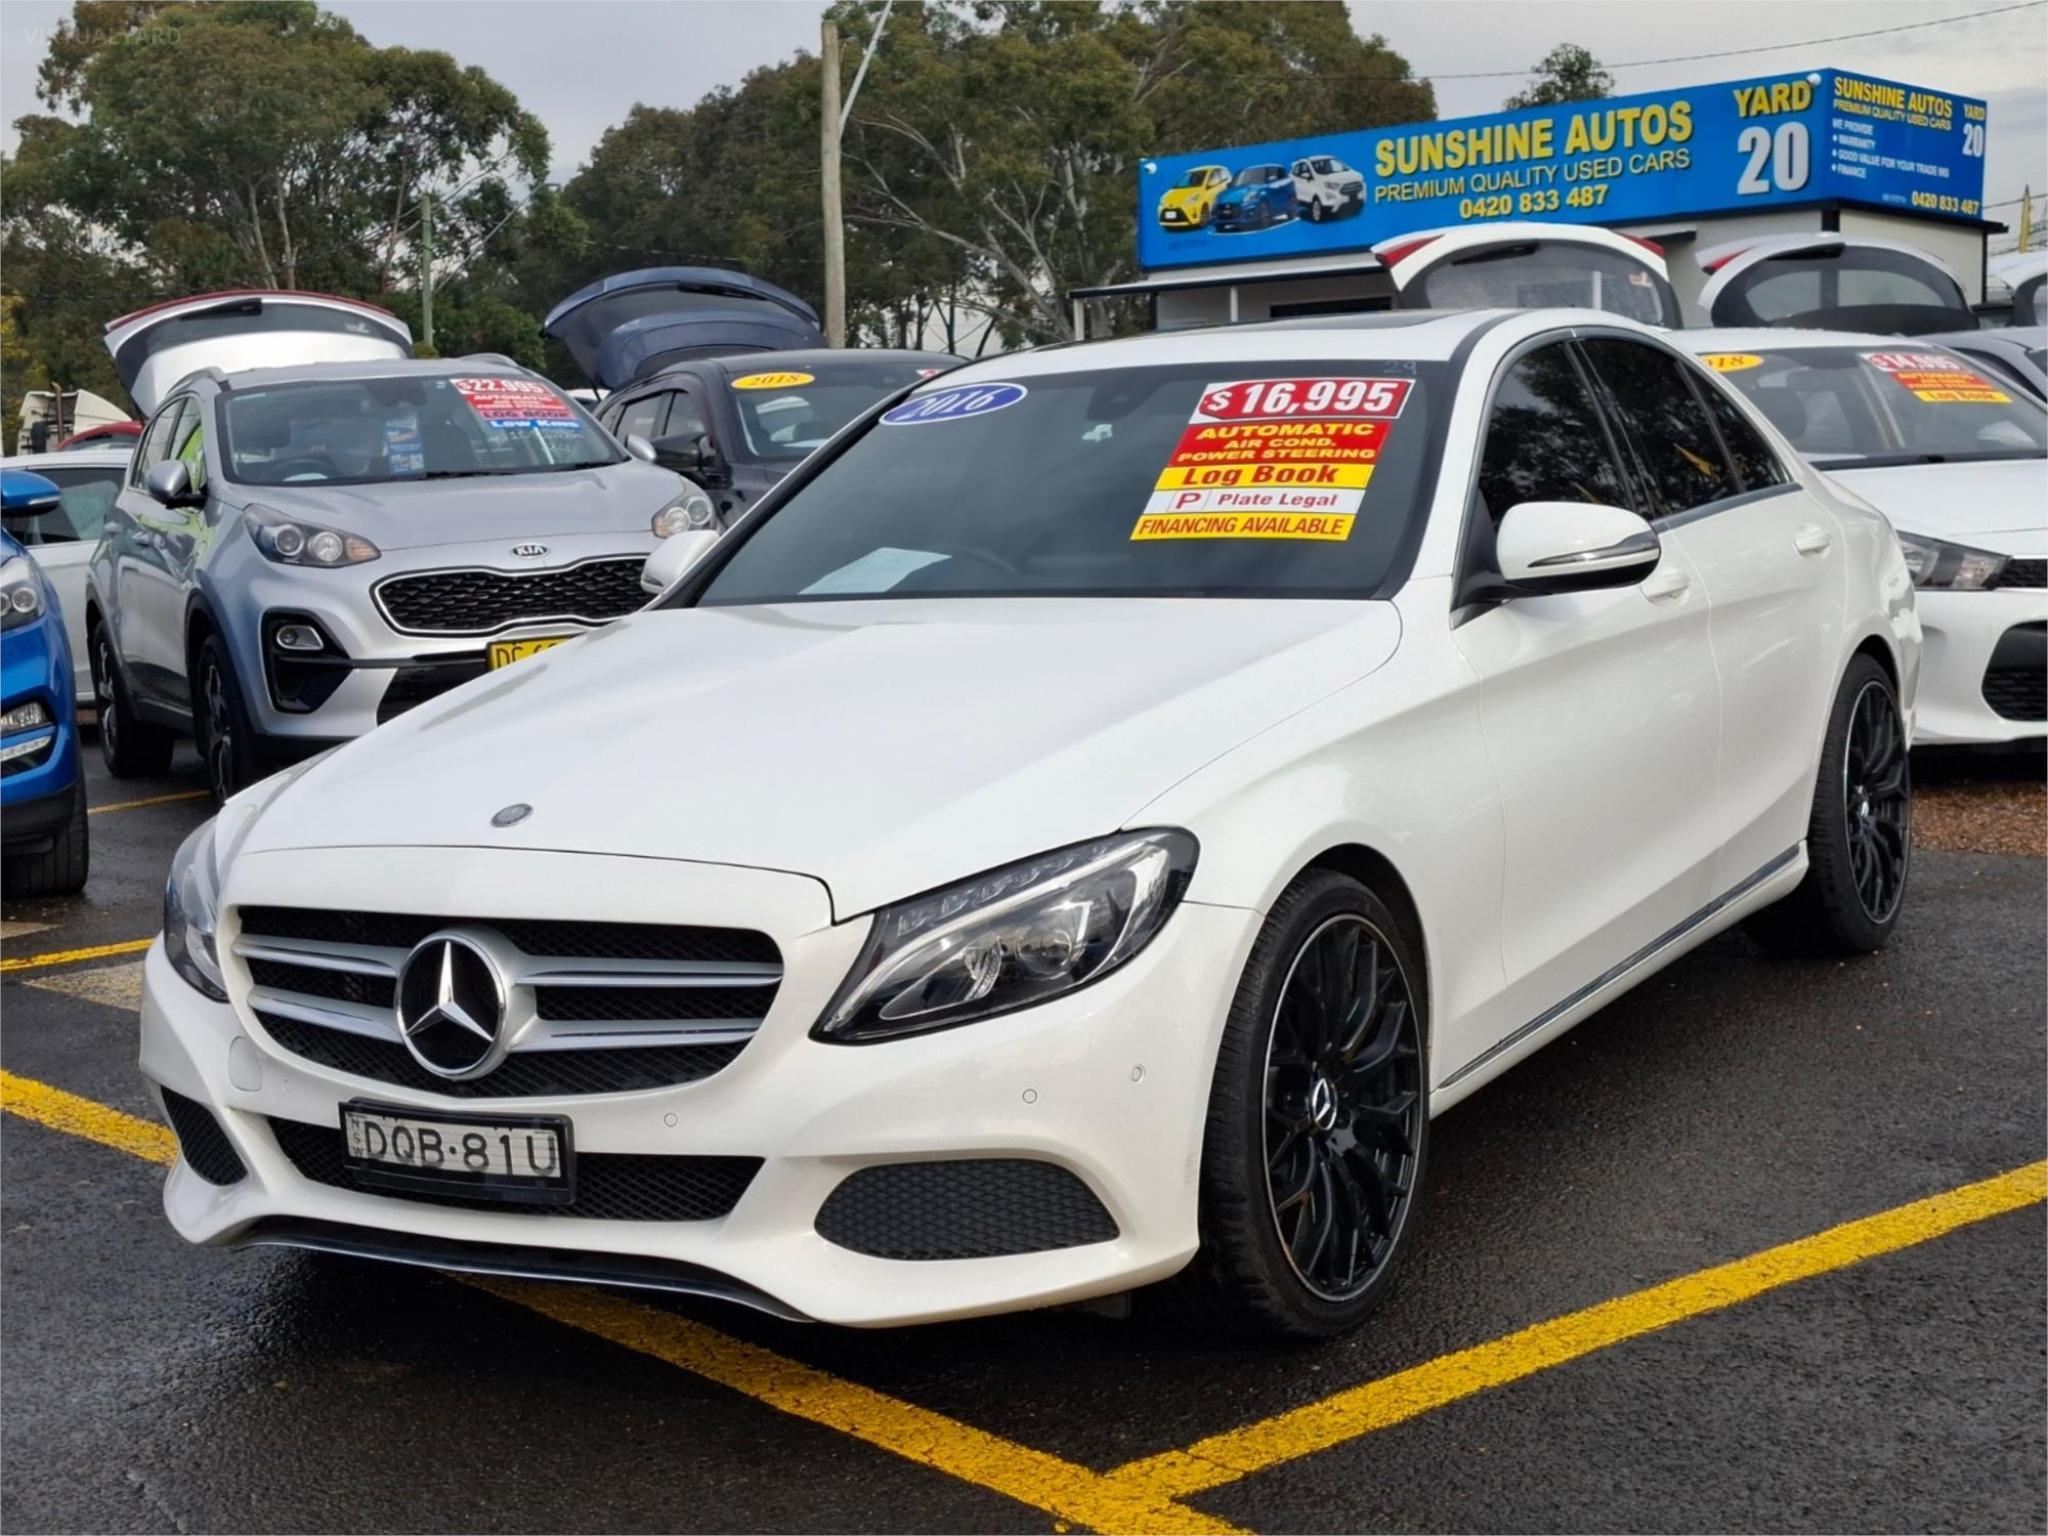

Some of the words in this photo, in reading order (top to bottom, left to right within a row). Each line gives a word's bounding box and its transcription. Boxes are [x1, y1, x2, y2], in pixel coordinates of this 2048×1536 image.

[1733, 80, 1811, 118] YARD
[1834, 76, 1905, 109] SUNSHINE
[1908, 91, 1952, 118] AUTOS
[1833, 98, 1871, 116] PREMIUM
[1872, 106, 1906, 122] QUALITY
[1907, 113, 1928, 127] USED
[1929, 117, 1952, 131] CARS
[1964, 104, 1985, 121] YARD
[1375, 119, 1553, 177] SUNSHINE
[1564, 101, 1692, 154] AUTOS
[1962, 122, 1983, 157] 20
[1737, 122, 1809, 196] 20
[1375, 175, 1464, 204] PREMIUM
[1471, 165, 1556, 193] QUALITY
[1564, 157, 1622, 182] USED
[1629, 148, 1690, 174] CARS
[1460, 194, 1512, 219] 0420
[1520, 189, 1559, 213] 833
[1566, 184, 1608, 207] 487
[1911, 190, 1937, 208] 0420
[1939, 194, 1959, 212] 833
[1961, 199, 1980, 215] 487
[749, 374, 801, 386] 2018
[893, 386, 1012, 421] 2016
[1196, 423, 1375, 441] AUTOMATIC
[1224, 438, 1263, 450] AIR
[1268, 437, 1337, 449] COND.
[1177, 450, 1255, 462] POWER
[1261, 448, 1375, 459] STEERING
[1182, 466, 1243, 487] Log
[1253, 464, 1339, 484] Book
[1175, 493, 1202, 510] P
[1217, 493, 1275, 507] Plate
[1279, 493, 1338, 510] Legal
[1139, 517, 1236, 536] FINANCING
[1243, 518, 1345, 535] AVAILABLE
[518, 544, 546, 556] KIA
